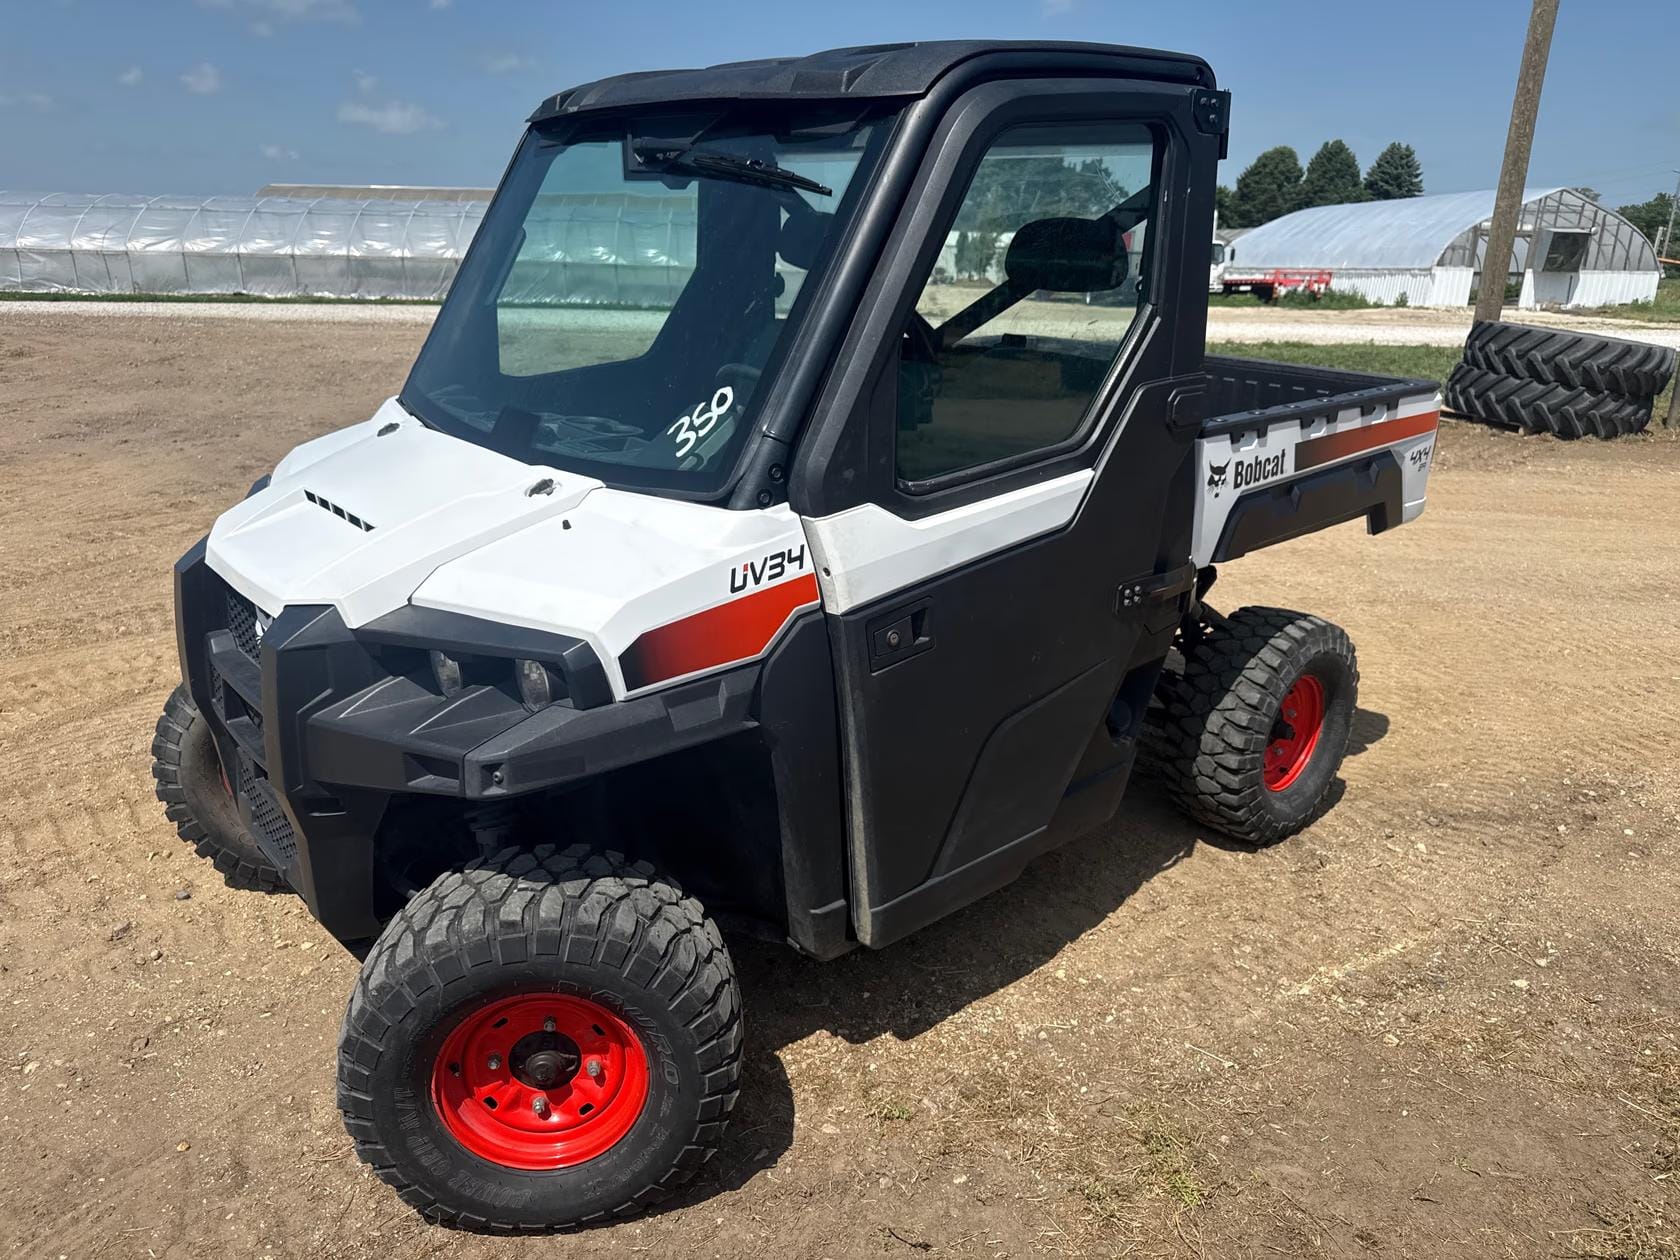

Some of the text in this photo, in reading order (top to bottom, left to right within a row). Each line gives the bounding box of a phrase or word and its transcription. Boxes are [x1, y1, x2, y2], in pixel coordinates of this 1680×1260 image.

[667, 386, 734, 457] 350
[1233, 448, 1286, 490] Bobcat
[730, 544, 805, 594] UV34
